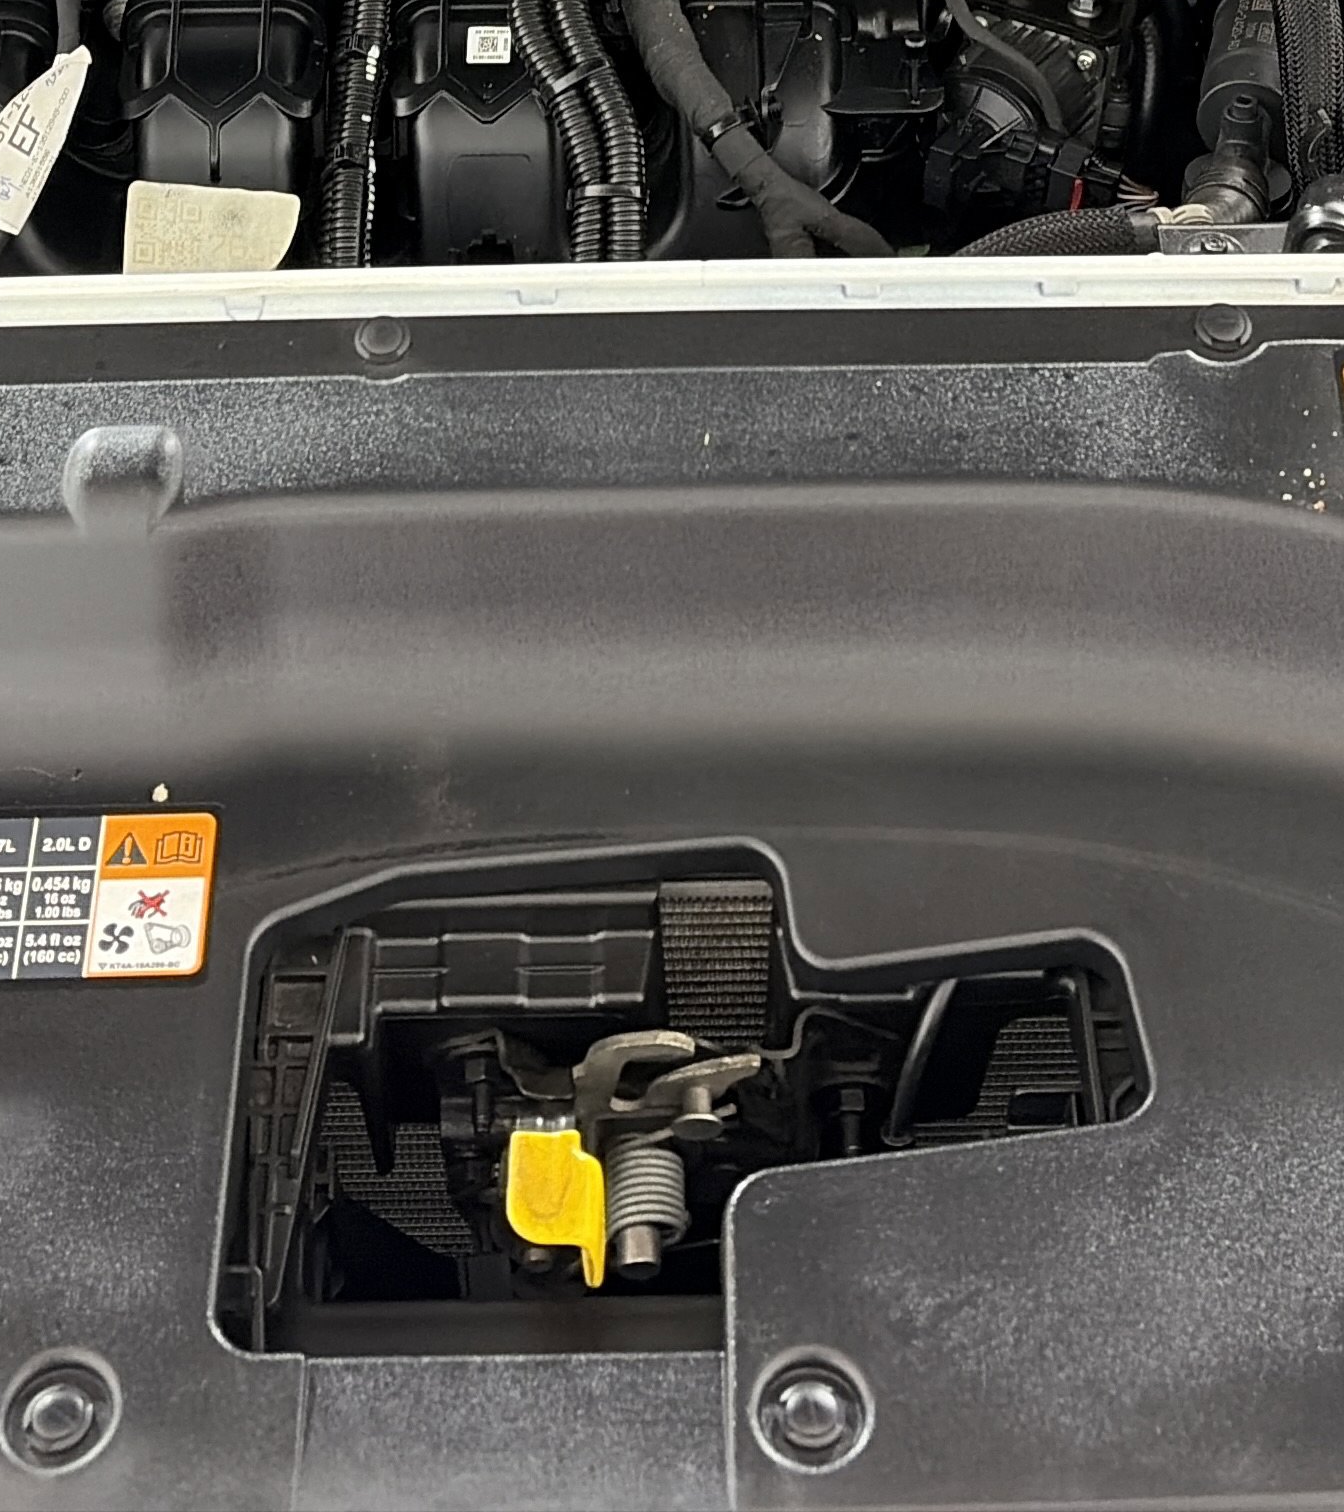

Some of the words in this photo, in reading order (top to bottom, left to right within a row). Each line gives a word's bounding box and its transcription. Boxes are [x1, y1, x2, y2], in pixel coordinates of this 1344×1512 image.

[8, 104, 40, 157] EF
[42, 838, 75, 852] 2.0L
[78, 837, 91, 851] D
[4, 878, 23, 895] kg
[32, 877, 71, 892] 0.454
[73, 877, 91, 894] kg
[44, 893, 58, 904] 16
[60, 894, 76, 904] oz
[35, 906, 59, 918] 1.00
[62, 906, 81, 918] lbs
[25, 934, 47, 947] 5.4
[50, 934, 59, 946] fl
[63, 935, 81, 946] oz
[23, 951, 54, 966] (160
[57, 950, 80, 966] cc)
